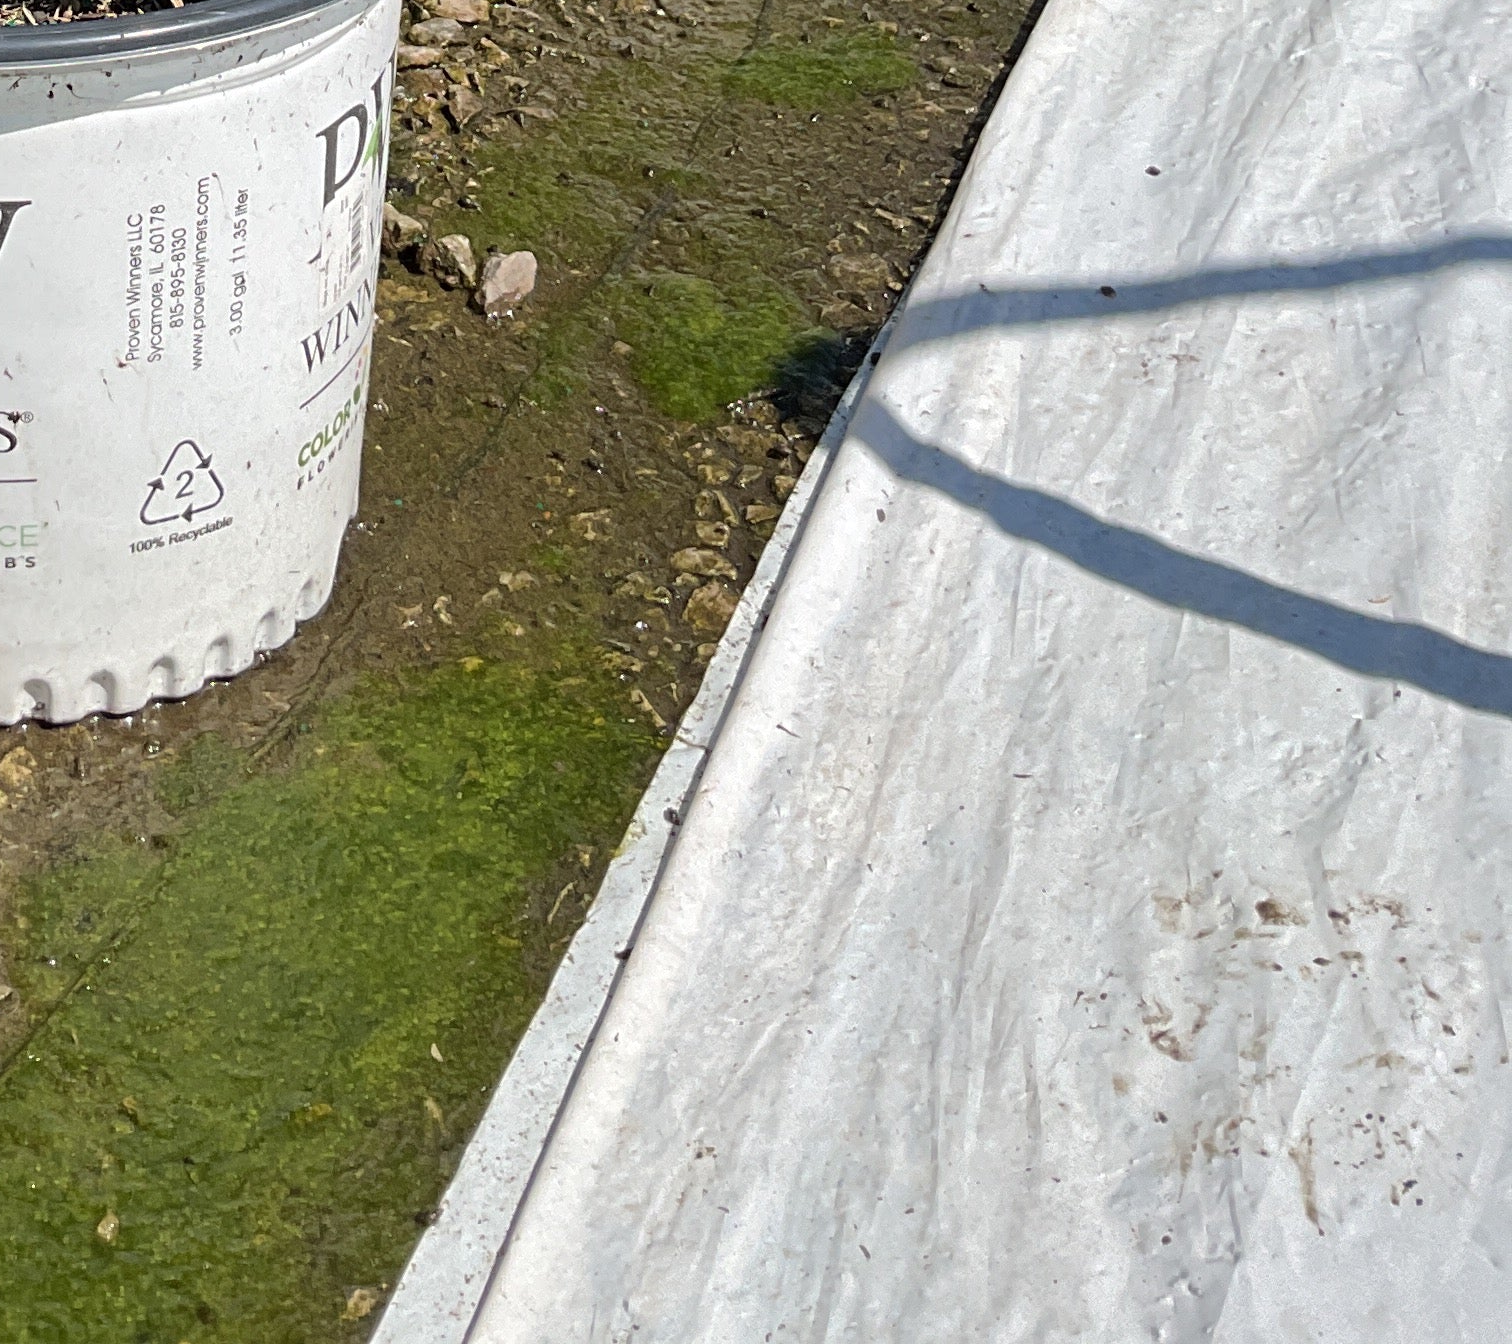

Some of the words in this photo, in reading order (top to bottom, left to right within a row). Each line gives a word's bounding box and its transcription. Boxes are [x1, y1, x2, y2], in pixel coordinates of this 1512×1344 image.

[234, 188, 249, 217] liter
[127, 213, 143, 242] LLC
[149, 204, 166, 254] 60178
[229, 218, 248, 264] 11.35
[126, 244, 143, 306] Winners
[149, 262, 164, 275] IL
[169, 227, 187, 329] 815-895-8130
[192, 176, 210, 371] www.provenwinners.com
[232, 270, 247, 298] gal
[125, 308, 141, 362] Proven
[147, 278, 165, 363] Sycamore,
[229, 300, 244, 337] 3.00
[297, 398, 351, 468] COLOR
[175, 469, 194, 500] 2
[129, 536, 165, 554] 100%
[168, 516, 234, 545] Recyclable
